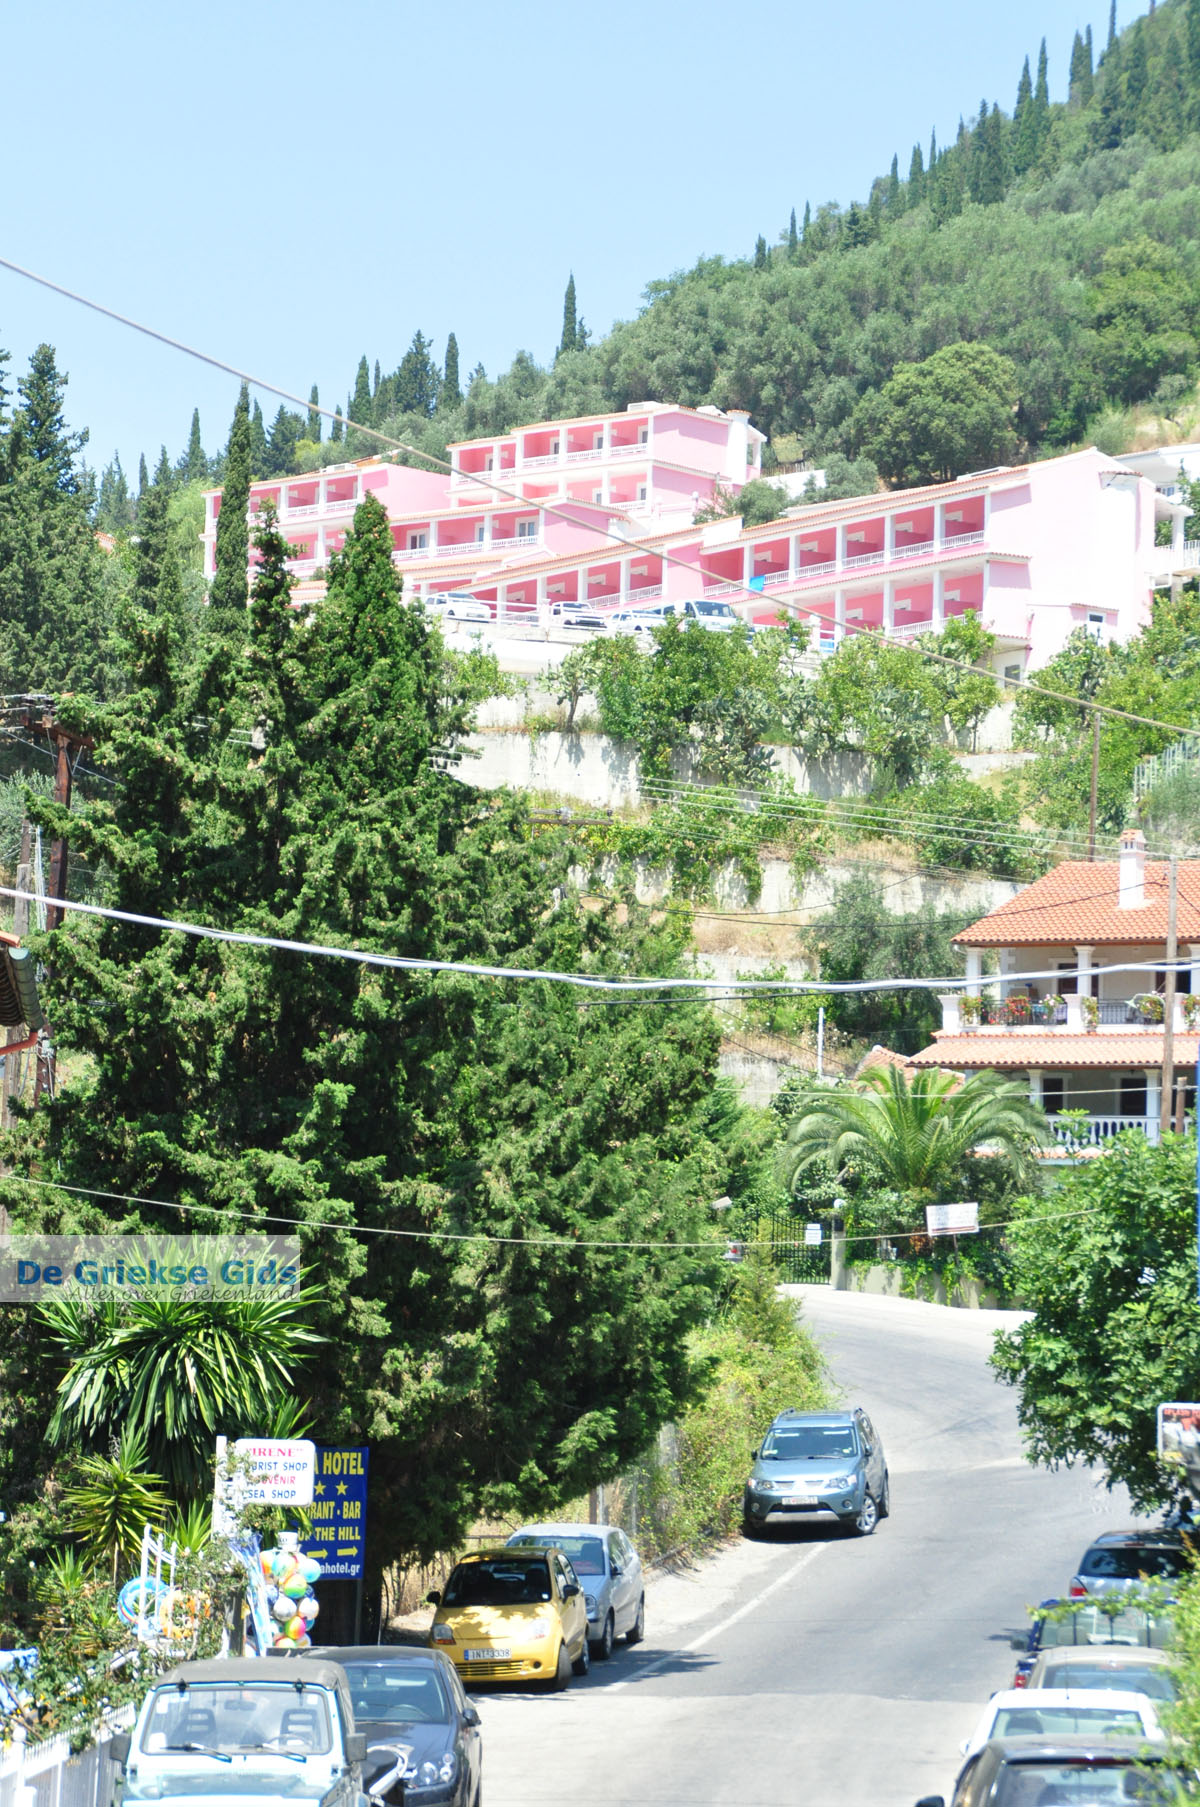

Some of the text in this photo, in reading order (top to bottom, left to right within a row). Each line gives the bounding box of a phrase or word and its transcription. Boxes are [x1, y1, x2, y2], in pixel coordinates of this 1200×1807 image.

[283, 1462, 308, 1471] SHOP
[322, 1451, 365, 1475] HOTEL
[271, 1489, 297, 1499] SHOP
[342, 1501, 361, 1519] BAR
[314, 1527, 336, 1541] THE
[338, 1526, 361, 1541] HILL
[320, 1562, 360, 1576] ahotel.gr
